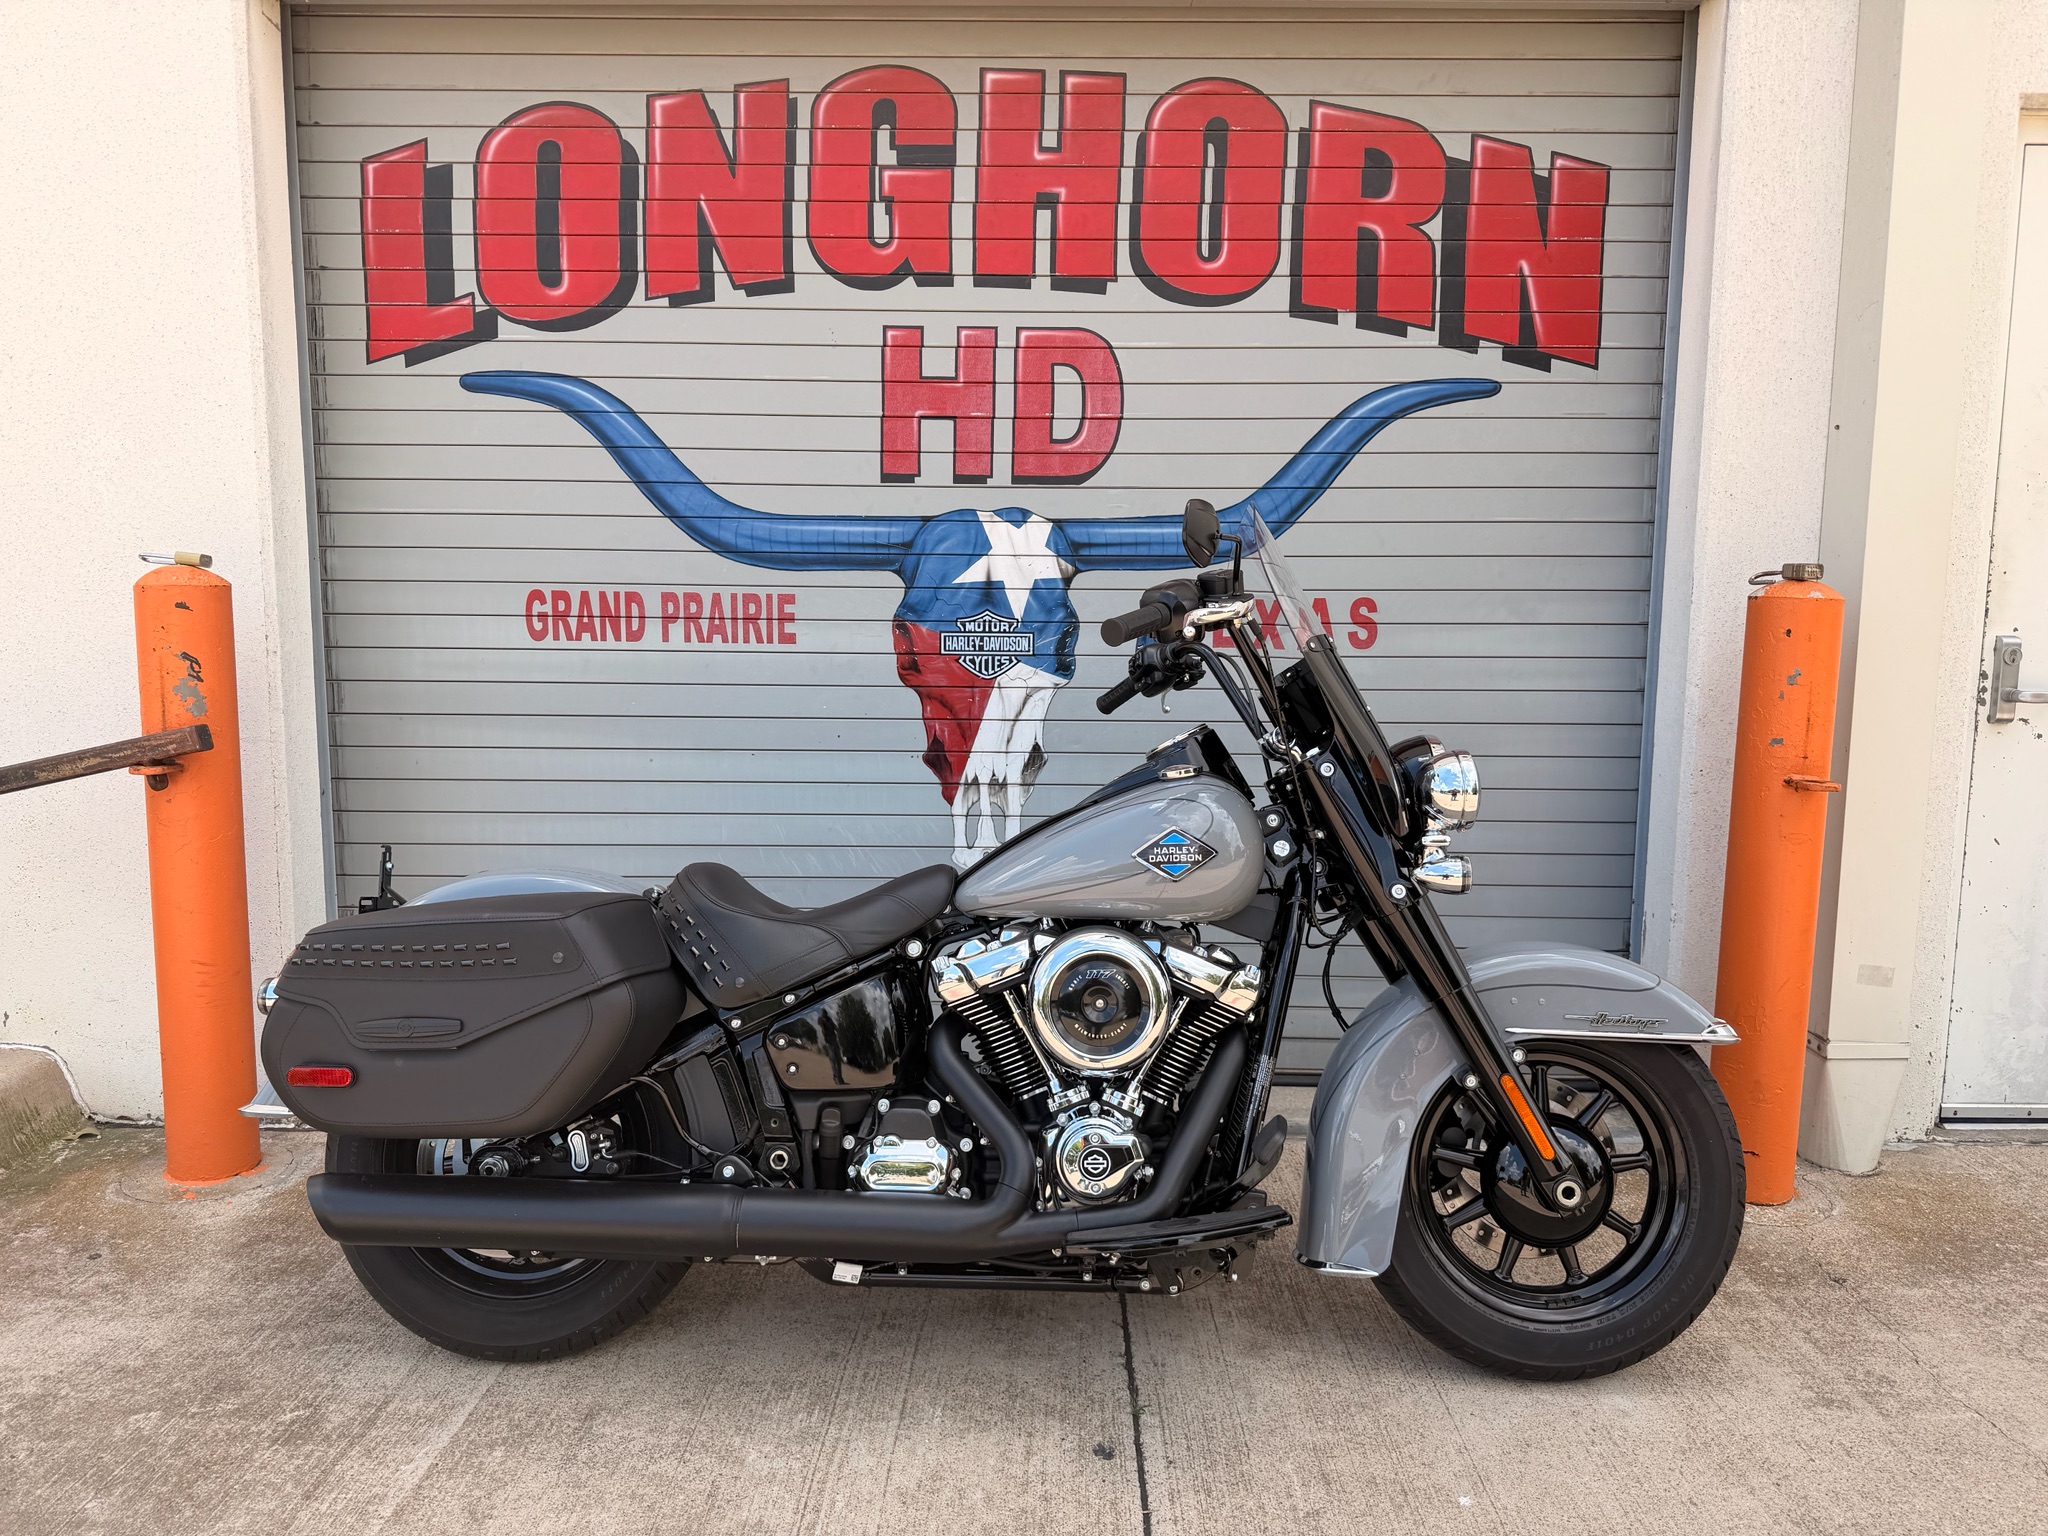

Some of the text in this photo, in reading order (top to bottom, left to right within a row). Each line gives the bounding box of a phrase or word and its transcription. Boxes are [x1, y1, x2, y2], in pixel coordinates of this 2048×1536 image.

[360, 63, 1611, 371] LONGHORN
[880, 325, 1124, 485] HD
[525, 588, 797, 645] GRAND PRAIRIE
[965, 615, 1009, 632] MOTOR
[945, 636, 1029, 651] HARLEY-DAVIDSON
[965, 655, 1010, 676] CYCLES
[1148, 854, 1203, 863] DAVIDSON
[1153, 846, 1198, 855] HARLEY-
[1085, 968, 1117, 979] 117
